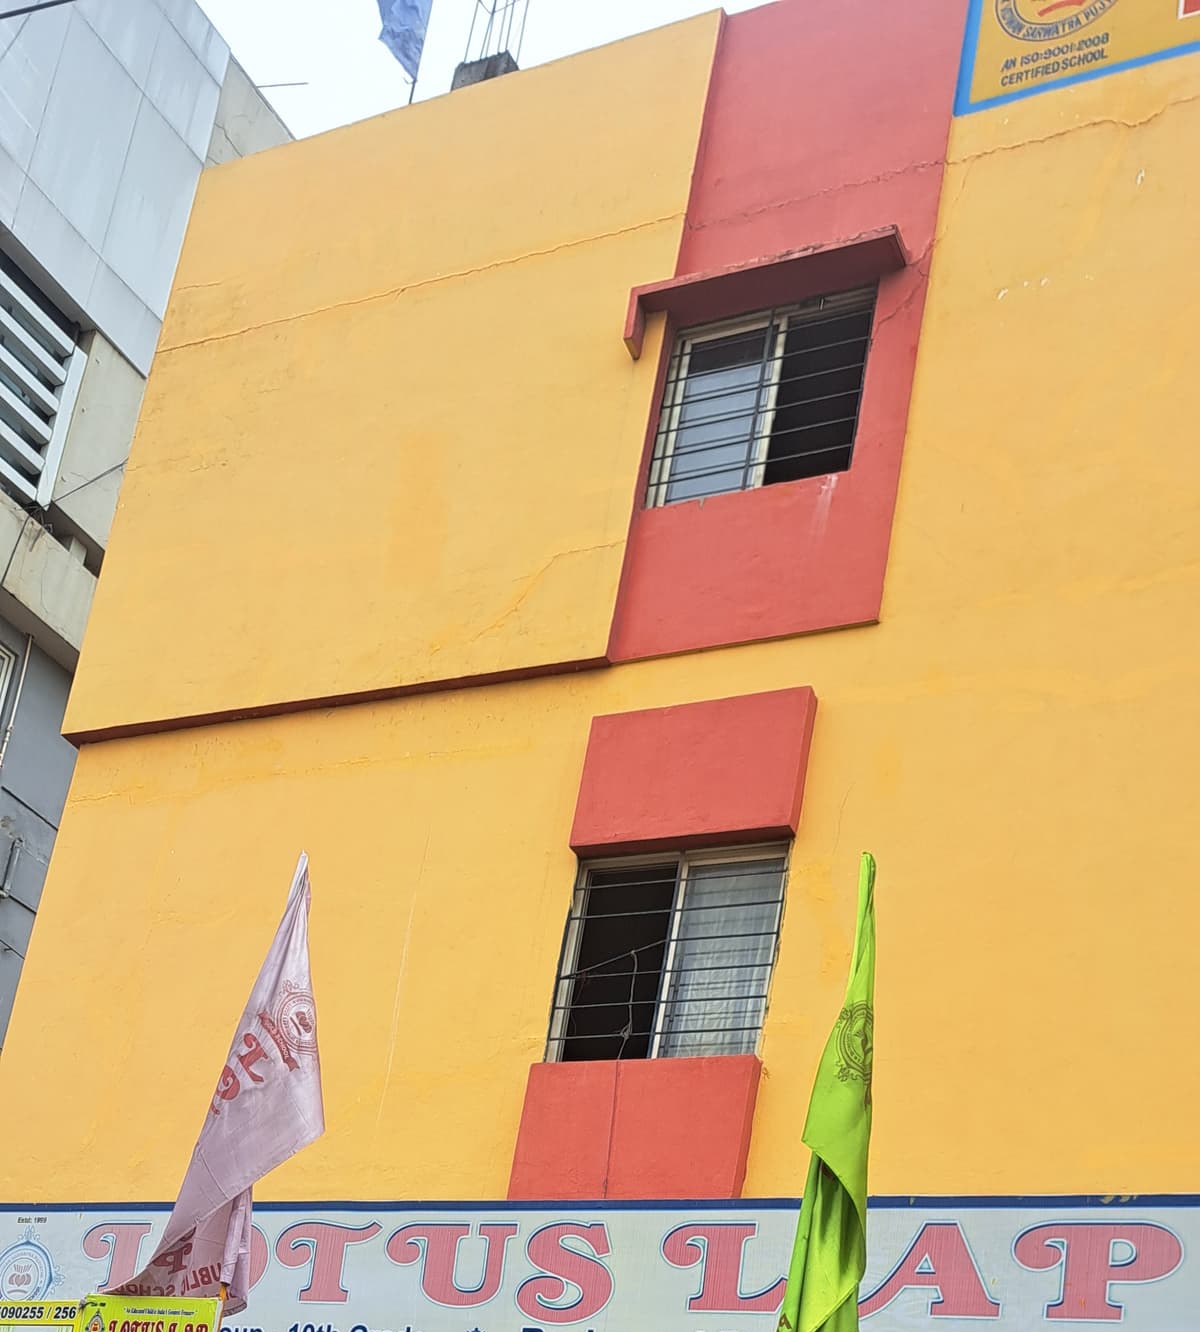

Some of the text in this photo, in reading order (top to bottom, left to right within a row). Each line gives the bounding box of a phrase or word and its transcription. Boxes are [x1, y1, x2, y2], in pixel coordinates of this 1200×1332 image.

[1000, 48, 1108, 87] CERTIFIED SCHOOL
[1001, 57, 1016, 72] AN
[660, 1219, 1185, 1323] LAP
[54, 1306, 76, 1320] 256
